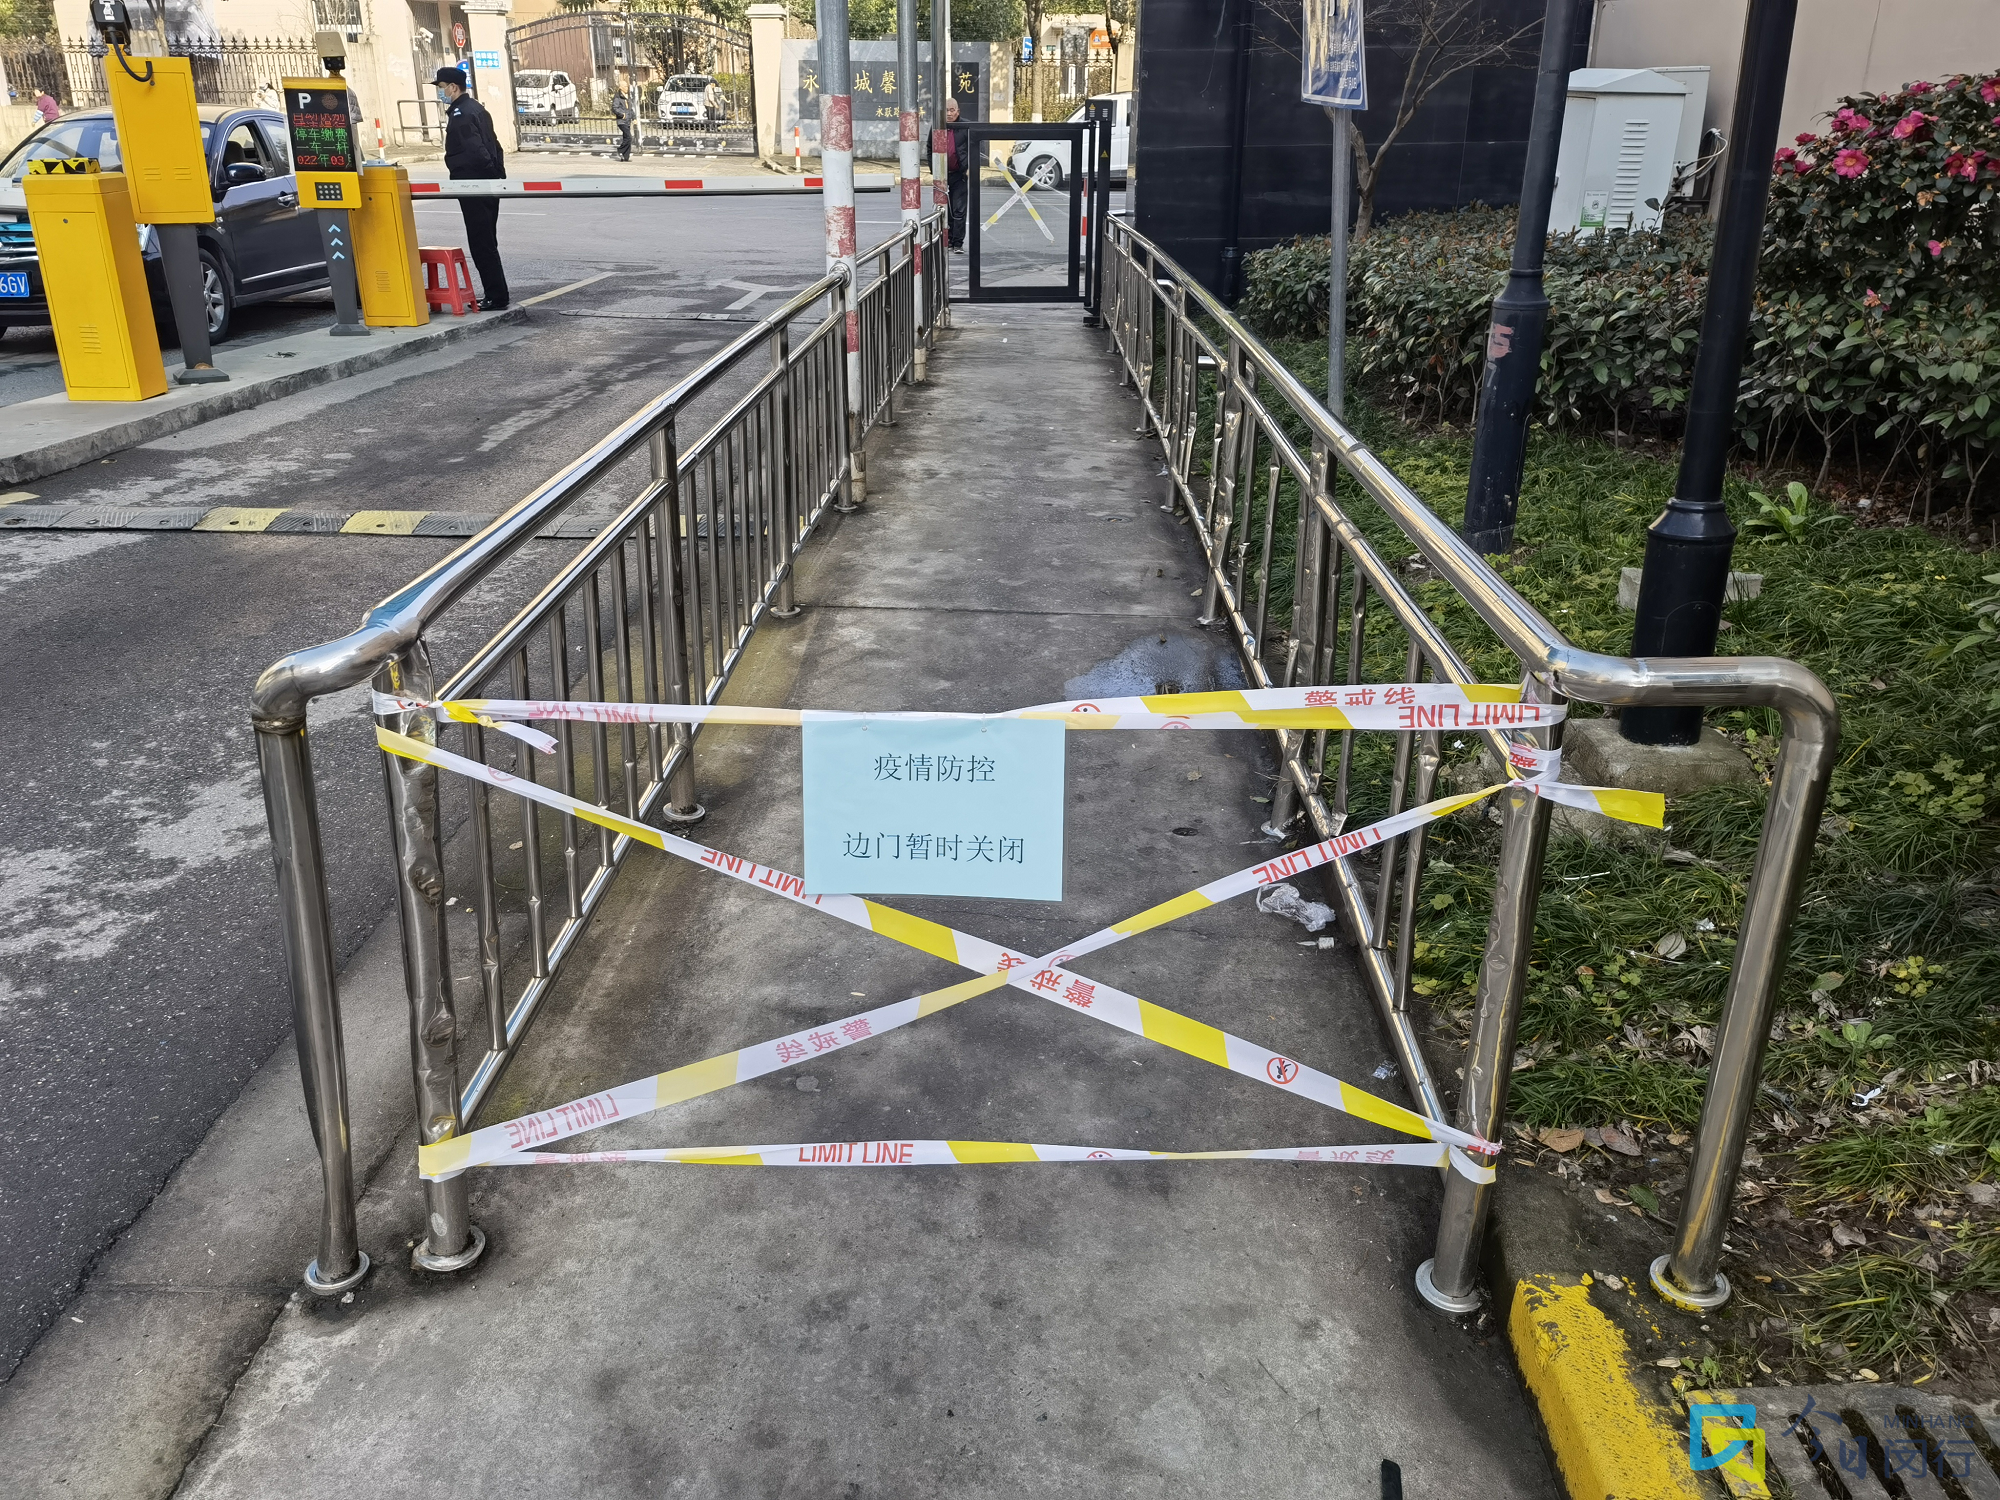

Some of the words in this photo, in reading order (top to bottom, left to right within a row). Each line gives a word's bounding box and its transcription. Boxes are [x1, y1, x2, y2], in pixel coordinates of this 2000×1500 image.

[803, 69, 975, 94] 永城馨苑
[298, 93, 311, 109] P
[295, 127, 347, 141] 停车缴费
[297, 141, 349, 154] 一车一杆
[1399, 704, 1459, 729] LINE
[1467, 704, 1540, 725] LIMIT
[873, 753, 996, 783] 疫情防控
[842, 831, 1024, 864] 边门暂时关闭
[1252, 850, 1312, 884] LINE
[798, 1142, 858, 1163] LIMIT
[862, 1142, 914, 1164] LINE
